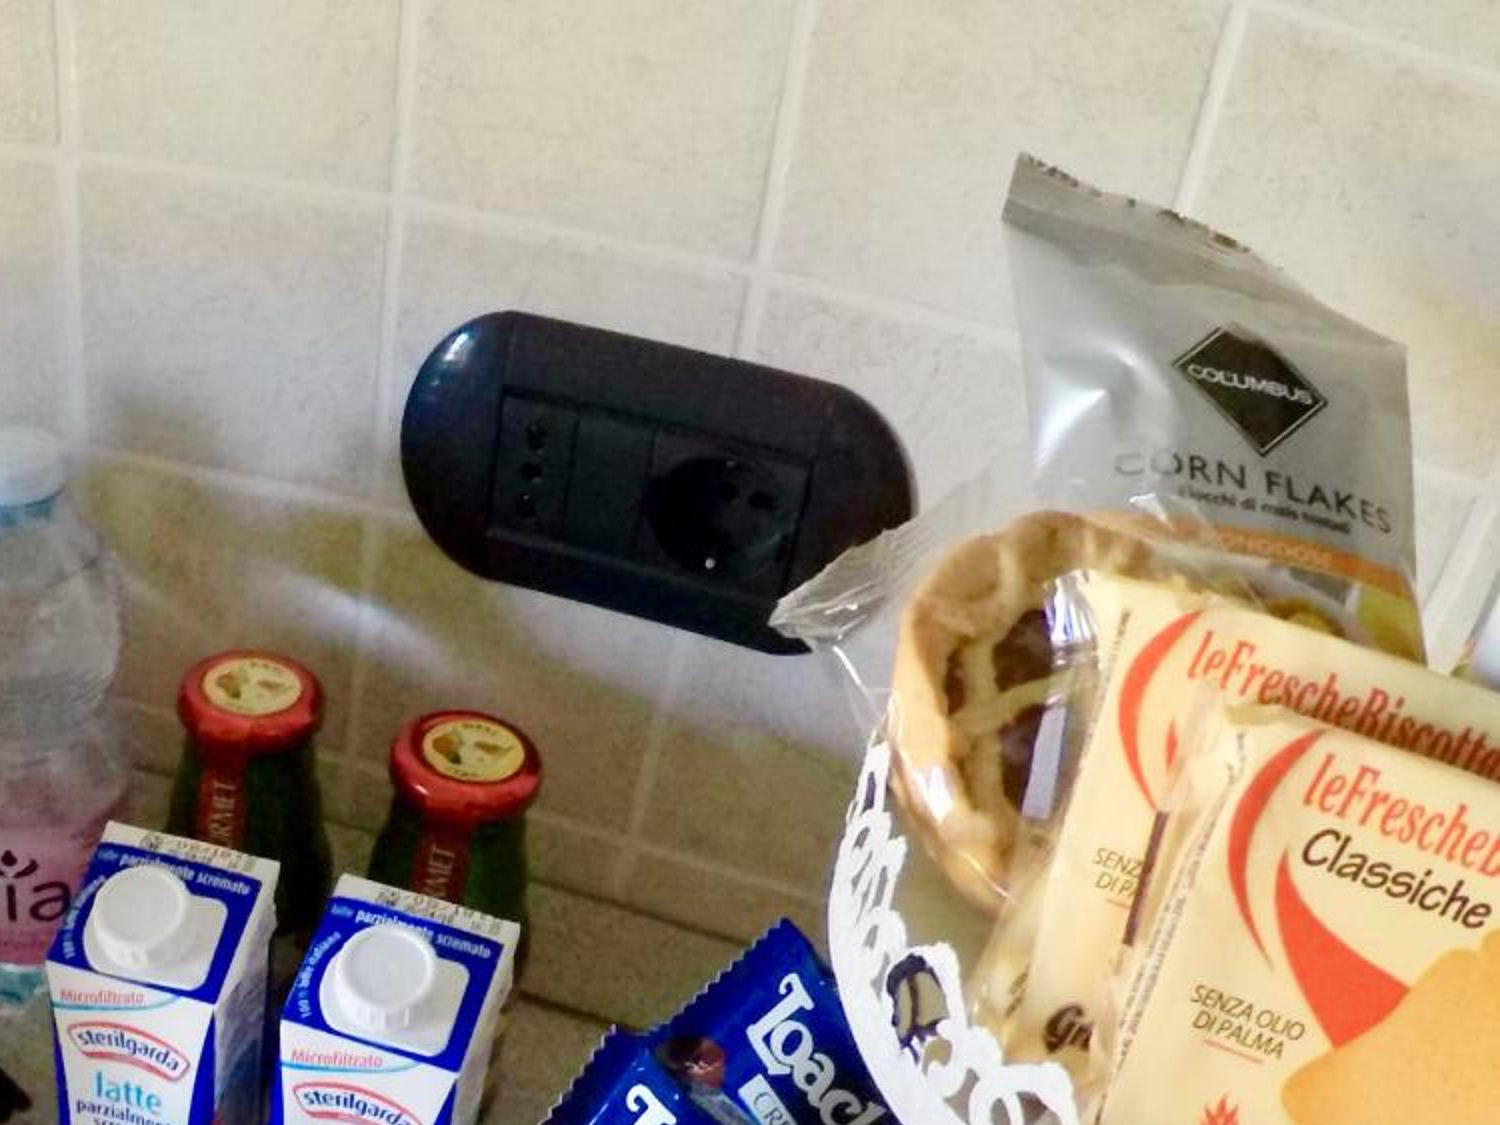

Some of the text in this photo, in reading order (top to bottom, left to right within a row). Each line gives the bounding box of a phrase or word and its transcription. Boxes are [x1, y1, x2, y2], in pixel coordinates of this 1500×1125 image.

[1187, 364, 1313, 405] COLUMBUS
[1113, 453, 1392, 534] CORN FLAKES
[1302, 829, 1492, 930] Classiche
[1190, 984, 1306, 1042] SENZA OLIO
[1191, 1009, 1286, 1060] DI PALMA
[77, 1027, 180, 1073] sterilgarda
[290, 1048, 384, 1068] Microfiltrato
[96, 1071, 163, 1115] latte
